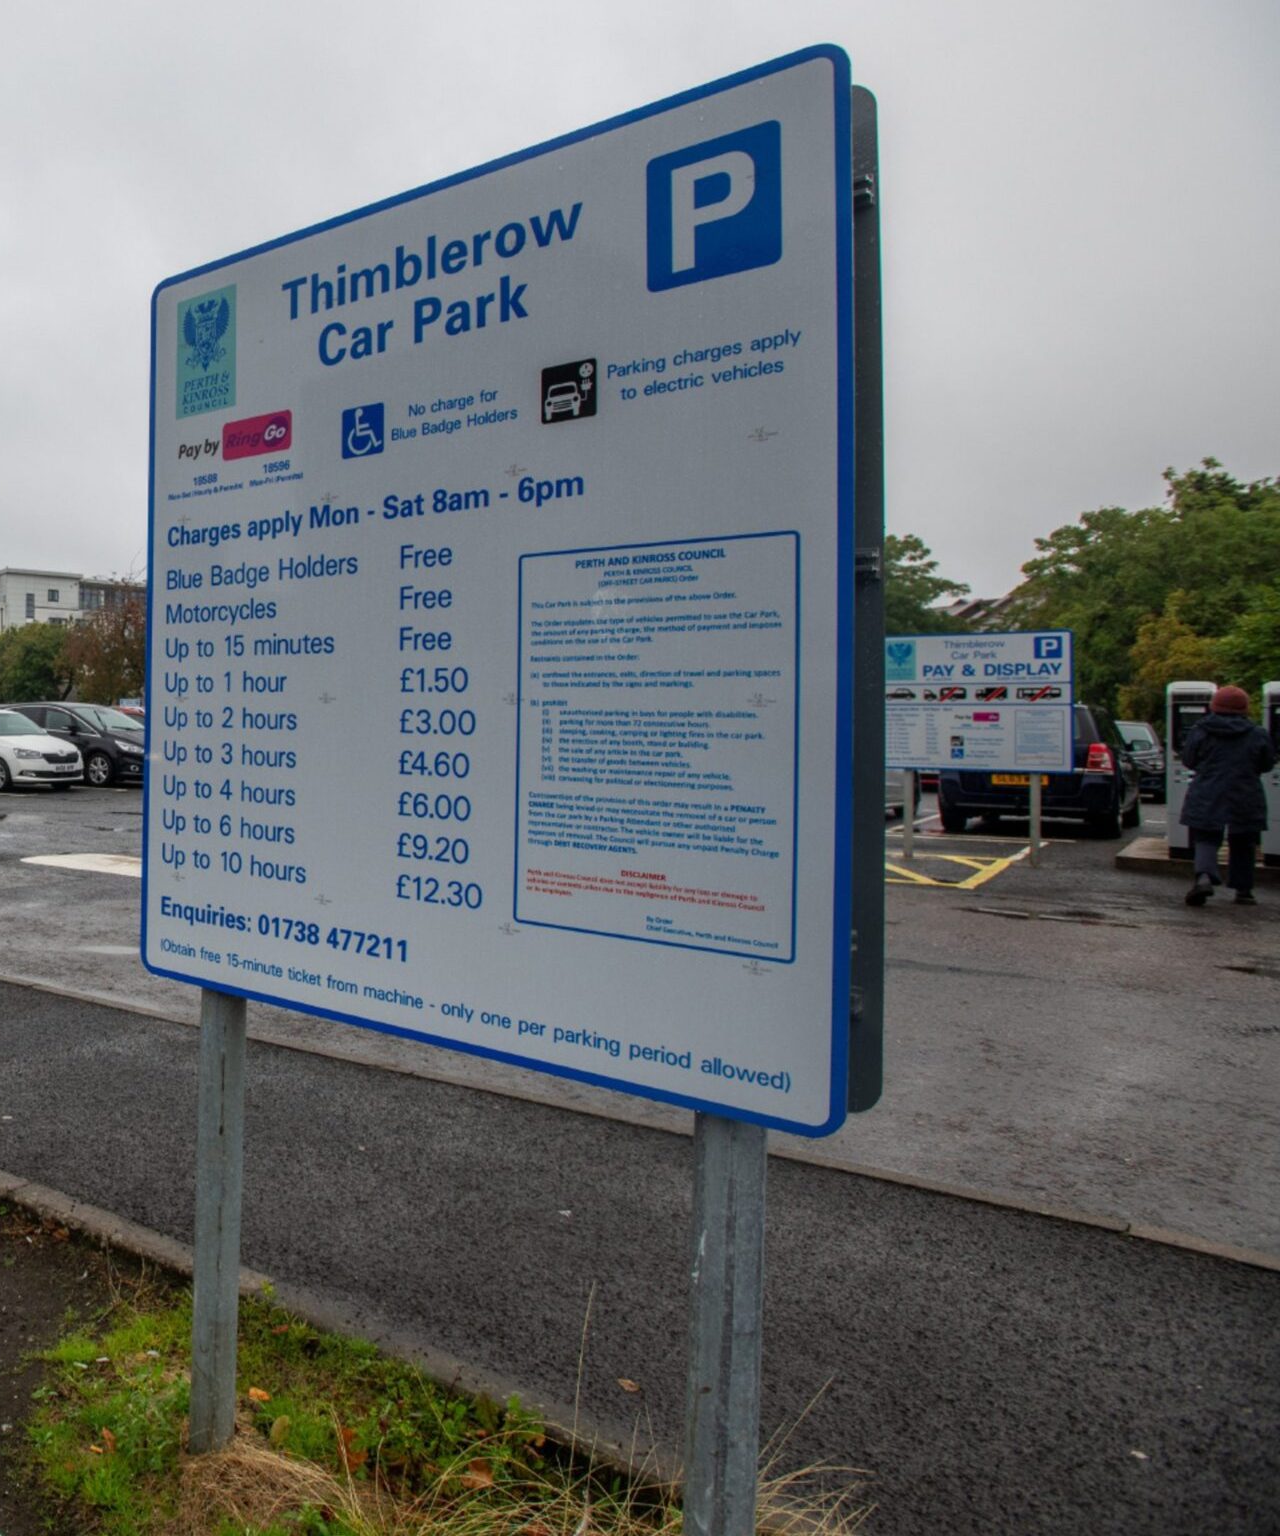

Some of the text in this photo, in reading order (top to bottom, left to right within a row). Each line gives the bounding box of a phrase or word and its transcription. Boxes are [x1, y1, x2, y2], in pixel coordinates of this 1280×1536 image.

[670, 150, 755, 274] P
[283, 204, 581, 318] Thimblerow
[319, 276, 527, 366] Car Park
[607, 329, 802, 379] Parking charges apply
[182, 383, 229, 405] KINROSS
[184, 373, 219, 392] PERTH
[620, 361, 784, 401] to electric vehicles
[183, 398, 228, 415] COUNCIL
[408, 390, 498, 417] No charge for
[391, 409, 518, 441] Blue Badge Holders
[178, 424, 286, 460] Pay by RingGo
[168, 524, 241, 547] Charges
[248, 511, 303, 540] apply
[310, 504, 359, 528] Mon
[383, 494, 424, 520] Sat
[433, 489, 490, 513] 8am
[518, 476, 584, 507] 6pm
[400, 544, 453, 569] Free
[575, 548, 726, 569] PERTH AND KINROSS COUNCIL
[167, 554, 358, 590] Blue Badge Holders
[166, 599, 276, 625] Motorcycles
[400, 586, 452, 610] Free
[165, 634, 334, 663] Up to 15 minutes
[399, 626, 452, 651] Free
[944, 640, 1005, 649] Thimblerow
[1041, 638, 1058, 656] P
[952, 650, 997, 660] Car Park
[165, 671, 287, 697] Up to 1 hour
[400, 667, 469, 693] £1.50
[923, 665, 954, 677] PAY
[962, 664, 975, 676] &
[984, 663, 1062, 676] DISPLAY
[164, 706, 297, 731] Up to 2 hours
[400, 709, 476, 736] £3.00
[164, 740, 296, 769] Up to 3 hours
[399, 750, 470, 778] £4.60
[163, 775, 296, 806] Up to 4 hours
[398, 792, 472, 822] £6.00
[163, 809, 295, 844] Up to 6 hours
[397, 833, 470, 864] £9.20
[162, 843, 307, 884] Up to 10 hours
[621, 870, 666, 881] DISCLAIMER
[397, 874, 483, 909] £12.30
[161, 896, 407, 962] Enquiries: 01738 477211
[160, 939, 196, 958] (Obtain
[200, 947, 221, 964] free
[227, 953, 283, 978] 15-minute
[288, 967, 321, 986] ticket
[327, 975, 358, 994] from
[364, 986, 423, 1009] machine
[441, 1003, 474, 1023] only
[480, 1012, 512, 1029] one
[518, 1020, 547, 1036] per
[553, 1028, 621, 1057] parking
[629, 1044, 692, 1069] period
[701, 1058, 791, 1092] allowed)
